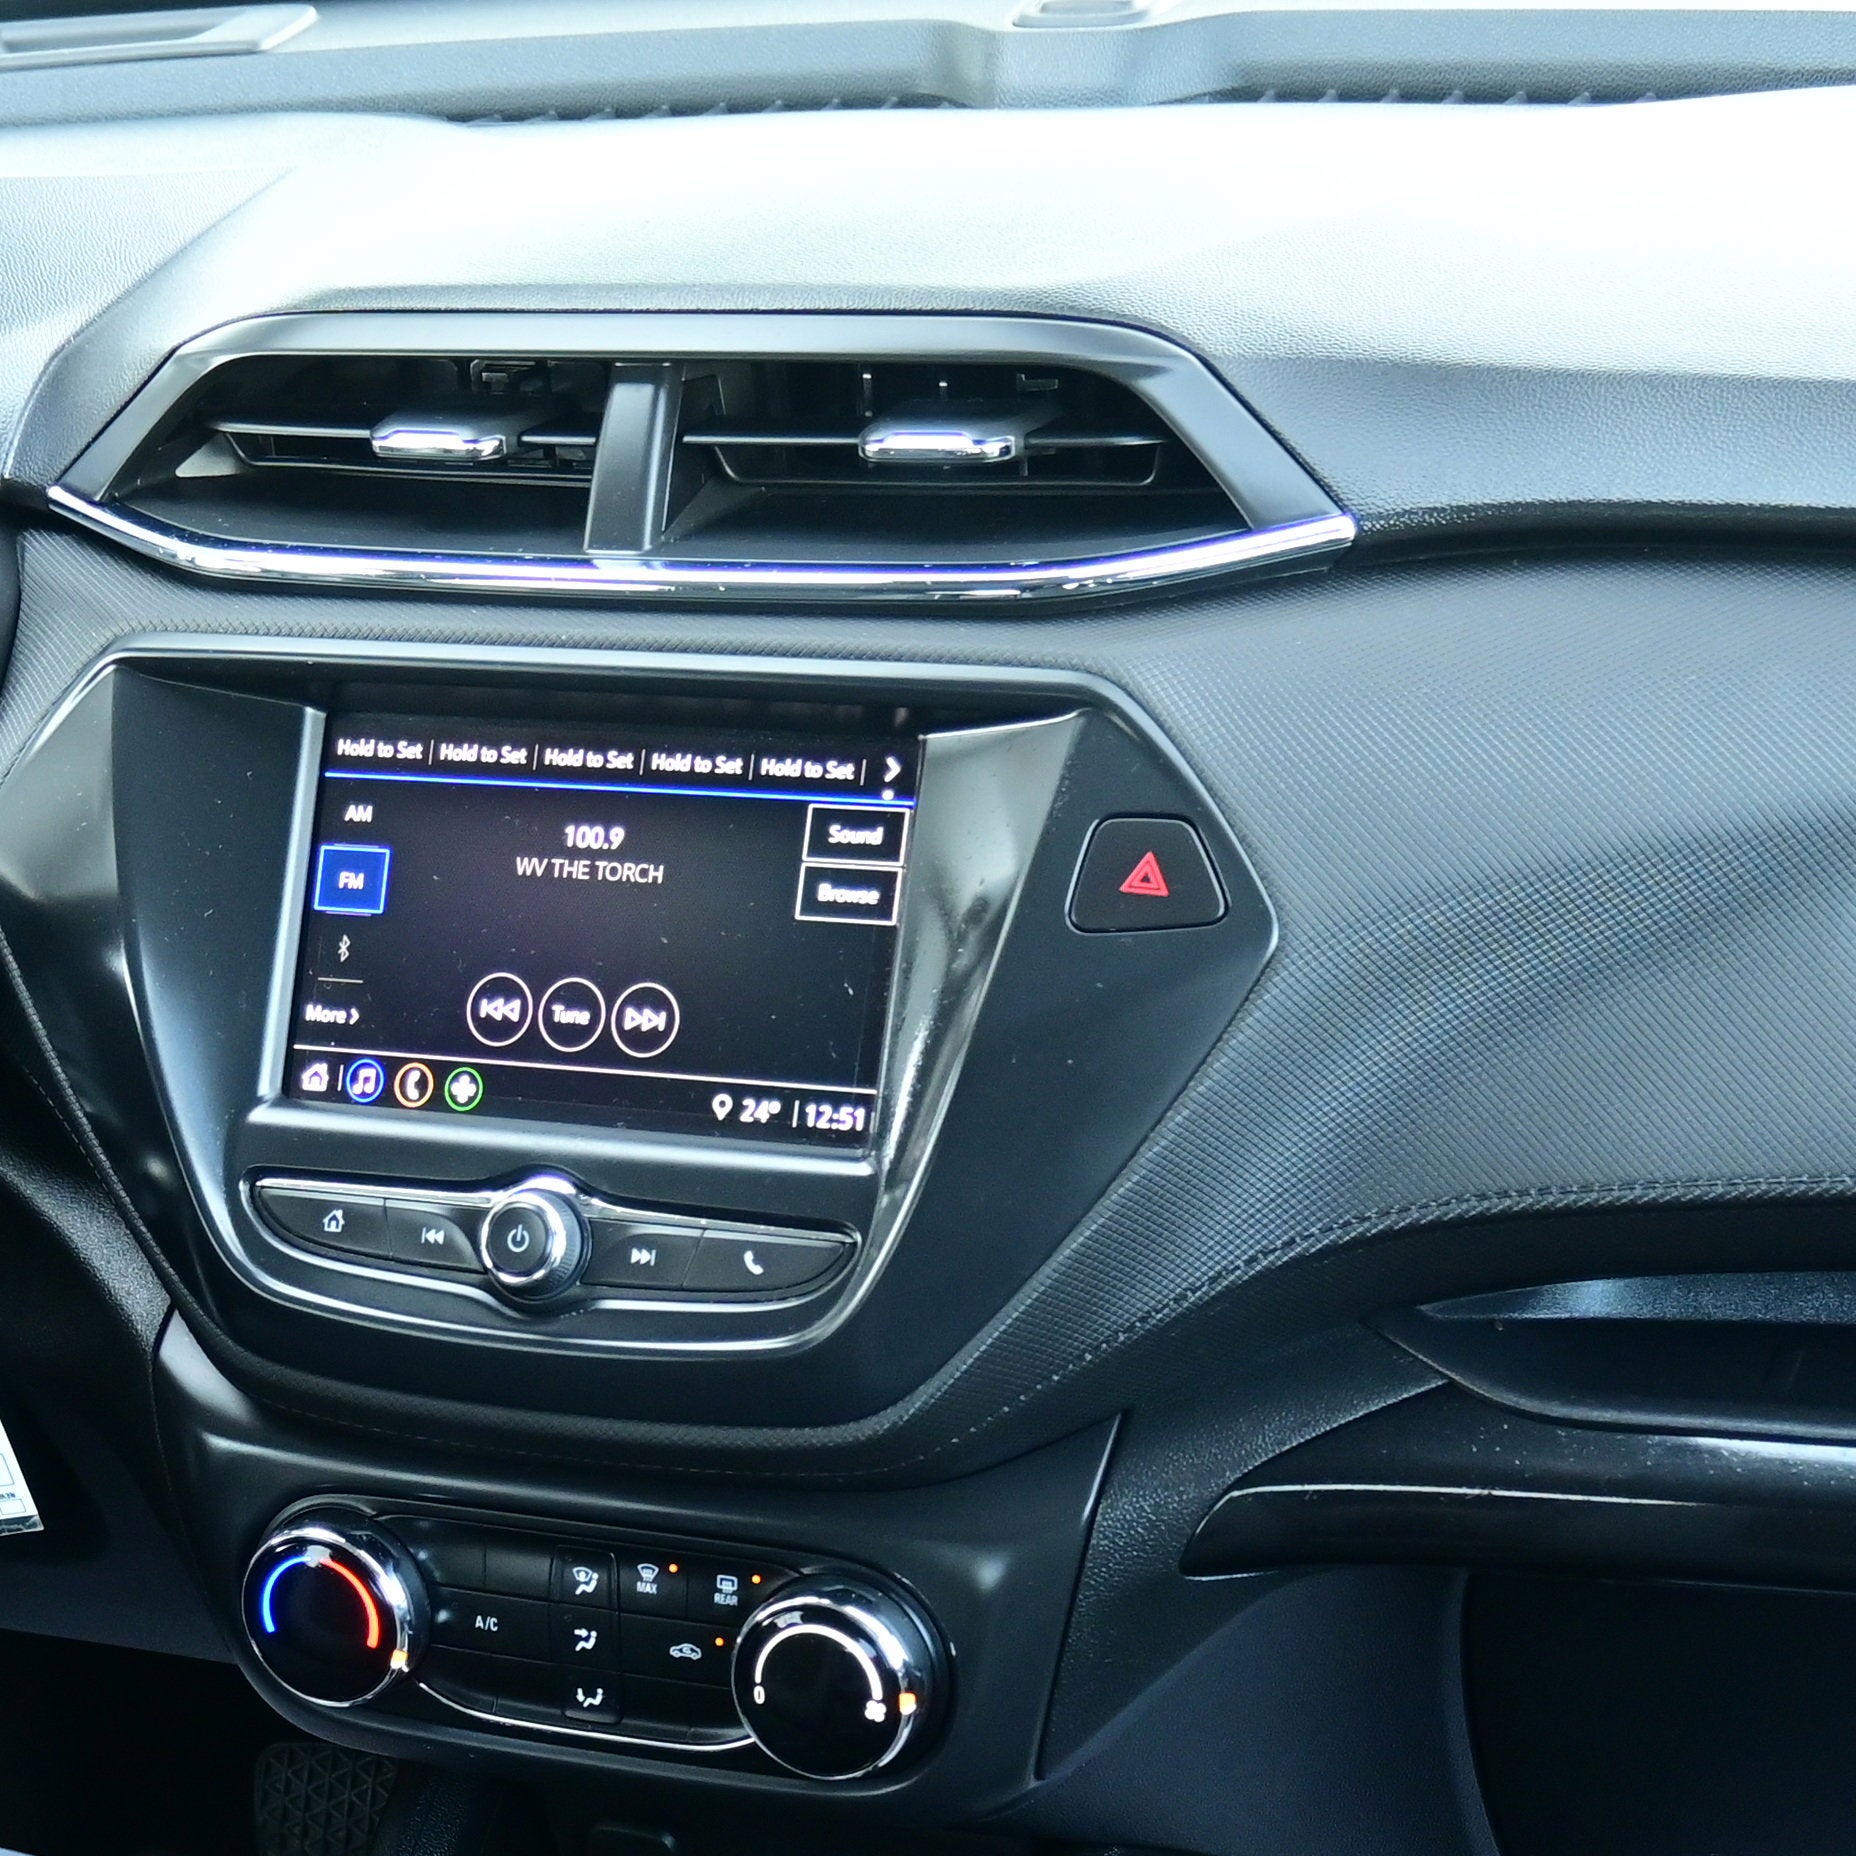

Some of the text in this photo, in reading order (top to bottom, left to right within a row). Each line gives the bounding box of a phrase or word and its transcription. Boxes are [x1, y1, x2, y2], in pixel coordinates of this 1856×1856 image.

[337, 739, 423, 760] Hold to Set
[440, 743, 527, 765] Hold to Set
[544, 748, 634, 770] Hold to Set
[651, 753, 743, 775] Hold to Set
[761, 758, 855, 780] Hold to Set
[344, 804, 373, 823] AM
[565, 825, 625, 850] 100.9
[828, 824, 884, 846] Sound
[338, 871, 364, 890] FM
[516, 857, 664, 884] WV THE TORCH
[817, 882, 880, 905] Browse
[305, 1004, 346, 1024] More
[551, 1004, 591, 1026] Tune
[805, 1104, 865, 1131] 12:51
[636, 1581, 657, 1595] MAX
[714, 1592, 738, 1607] REAR
[475, 1615, 498, 1632] A/C
[753, 1685, 765, 1704] 0
